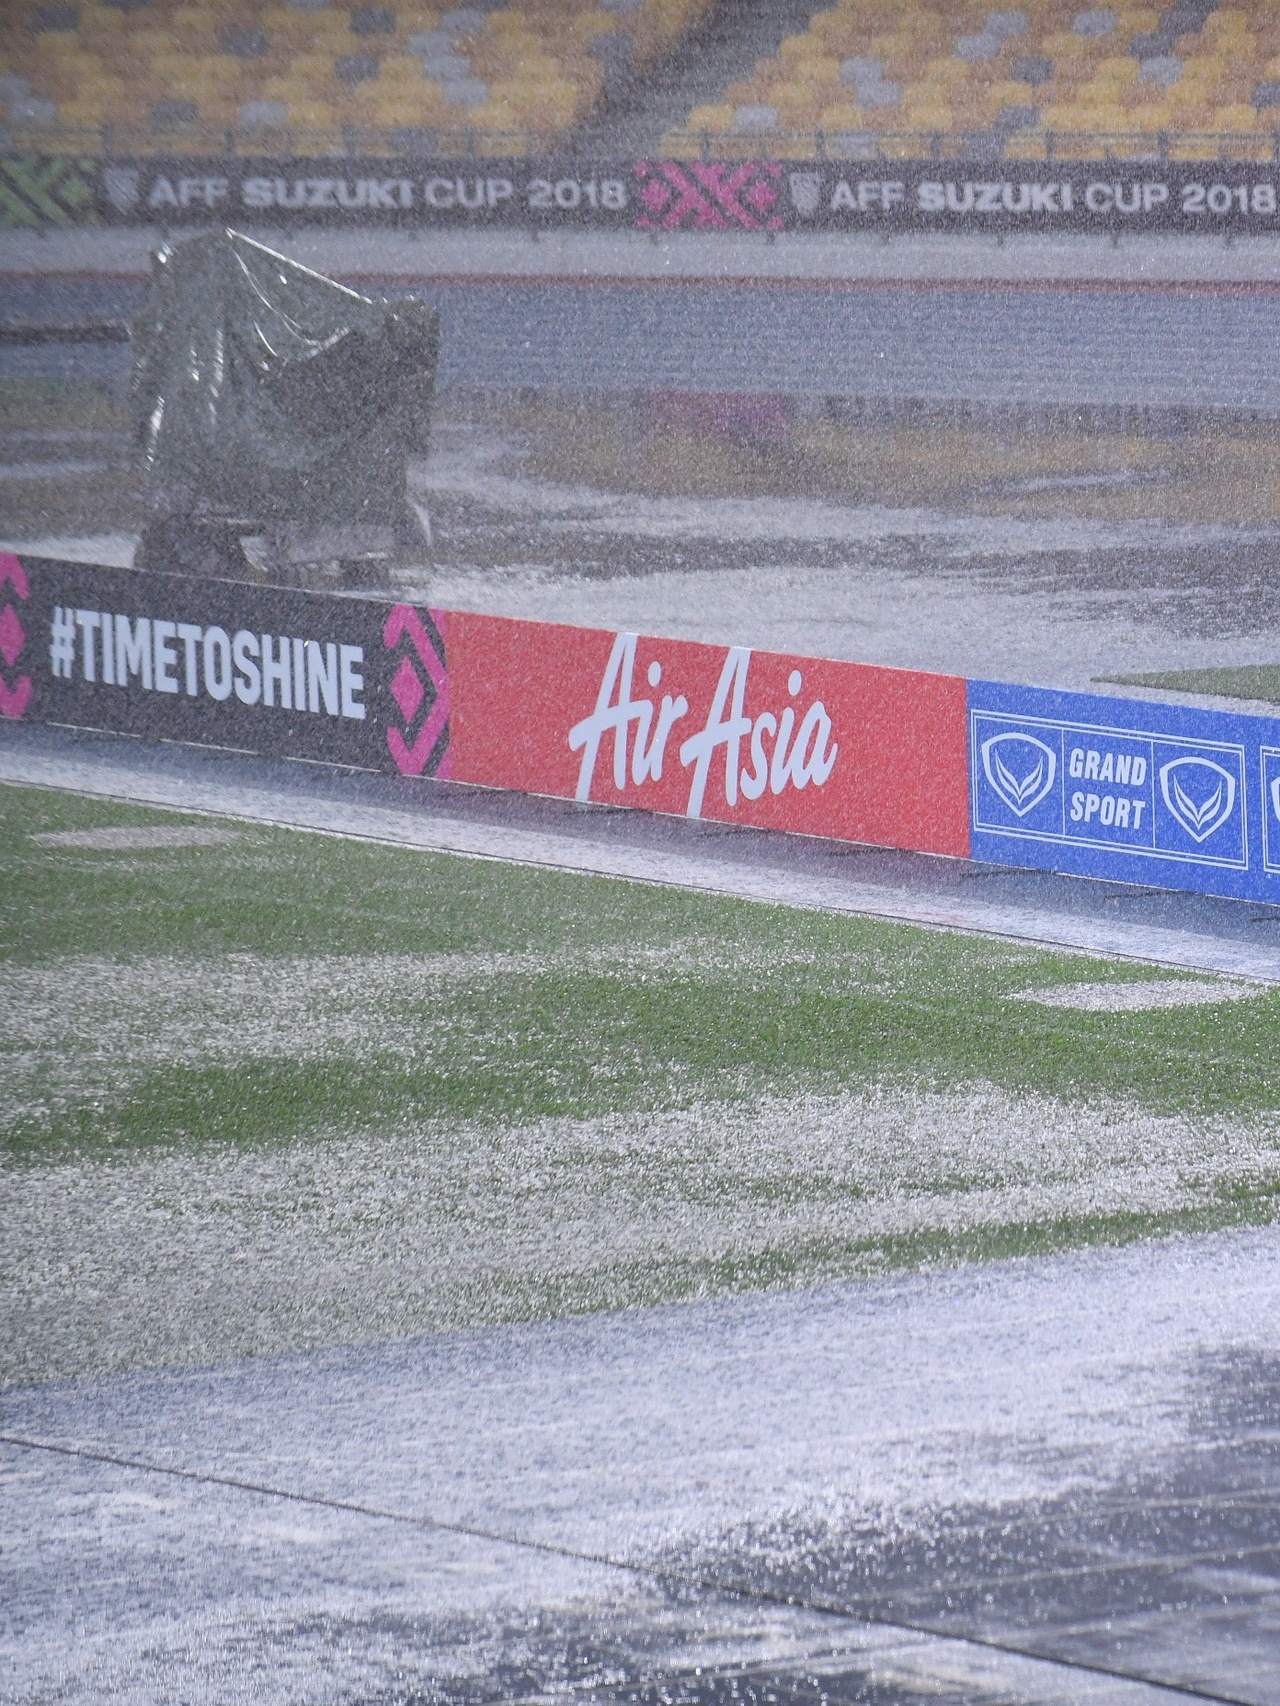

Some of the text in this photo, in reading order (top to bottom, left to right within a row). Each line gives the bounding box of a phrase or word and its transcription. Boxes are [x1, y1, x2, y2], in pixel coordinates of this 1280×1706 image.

[148, 177, 628, 210] AFF SUZUKI CUP 2018
[830, 181, 1277, 214] AFF SUZUKI CUP 2018
[50, 606, 366, 719] #TIMETOSHINE
[1068, 746, 1148, 788] GRAND
[1070, 791, 1147, 831] SPORT
